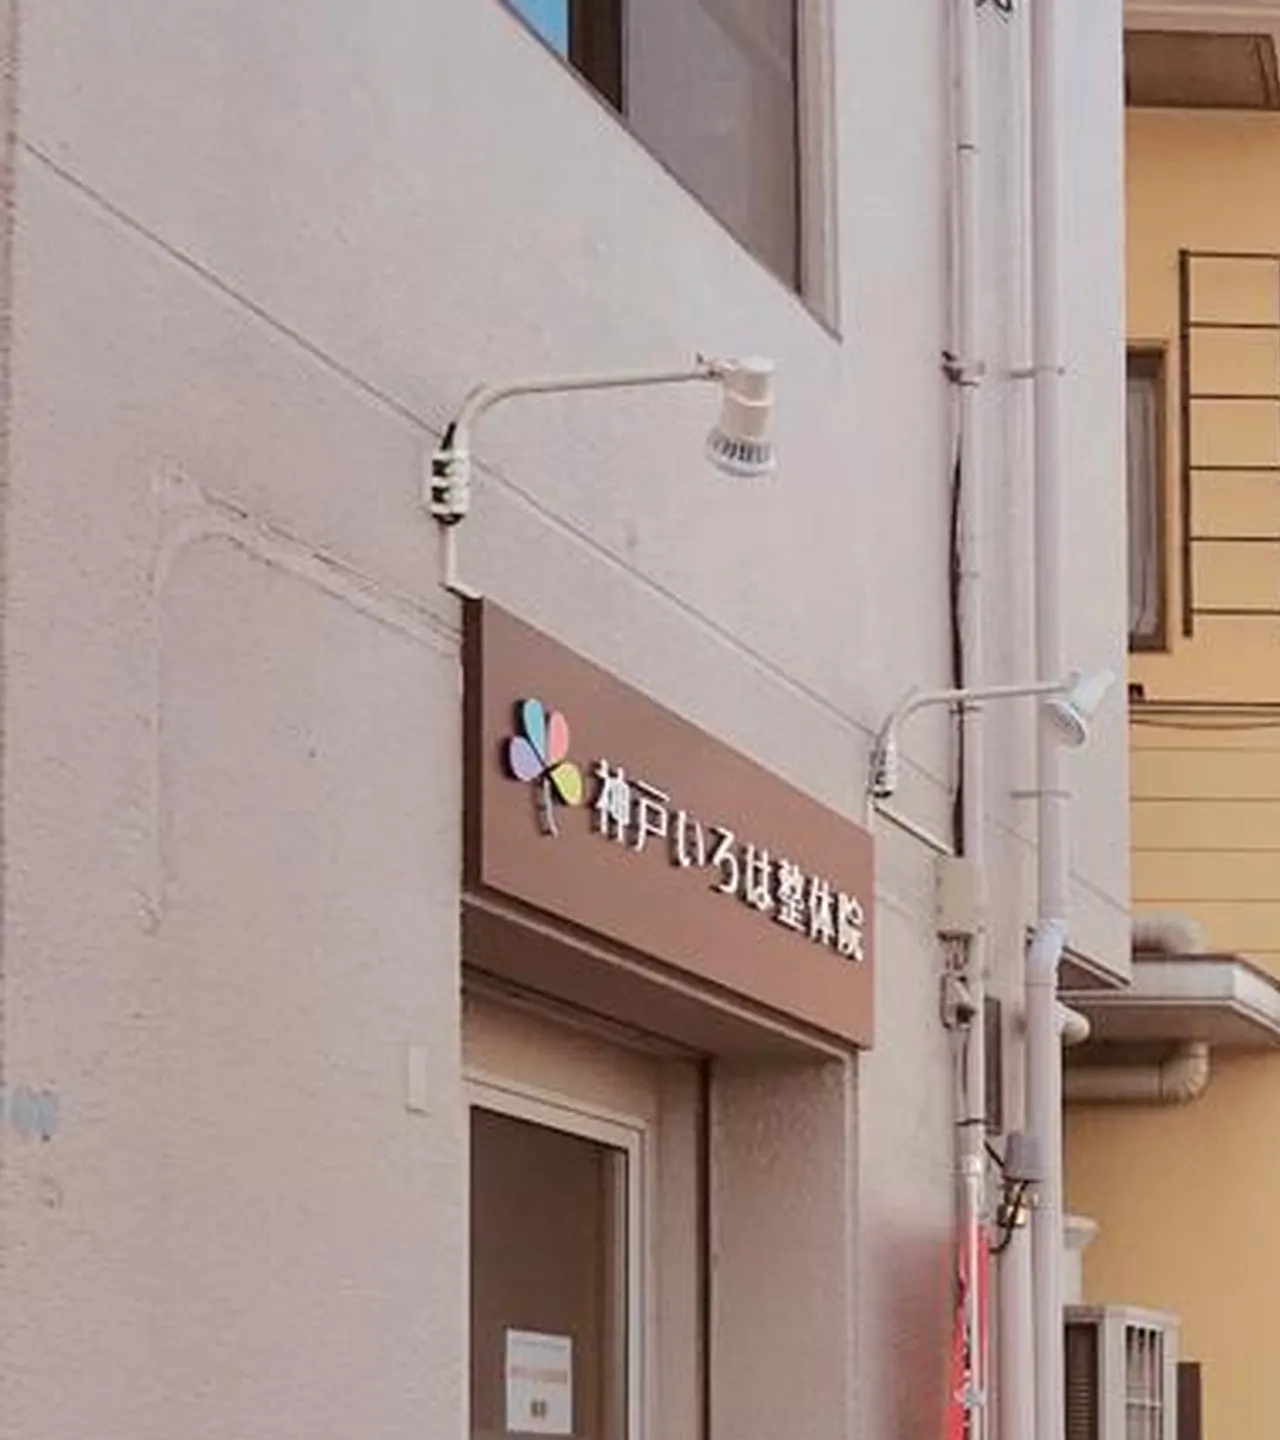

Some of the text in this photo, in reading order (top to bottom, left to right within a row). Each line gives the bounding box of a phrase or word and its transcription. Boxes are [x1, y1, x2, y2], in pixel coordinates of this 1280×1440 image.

[594, 759, 866, 962] 神戸いろは整体院
